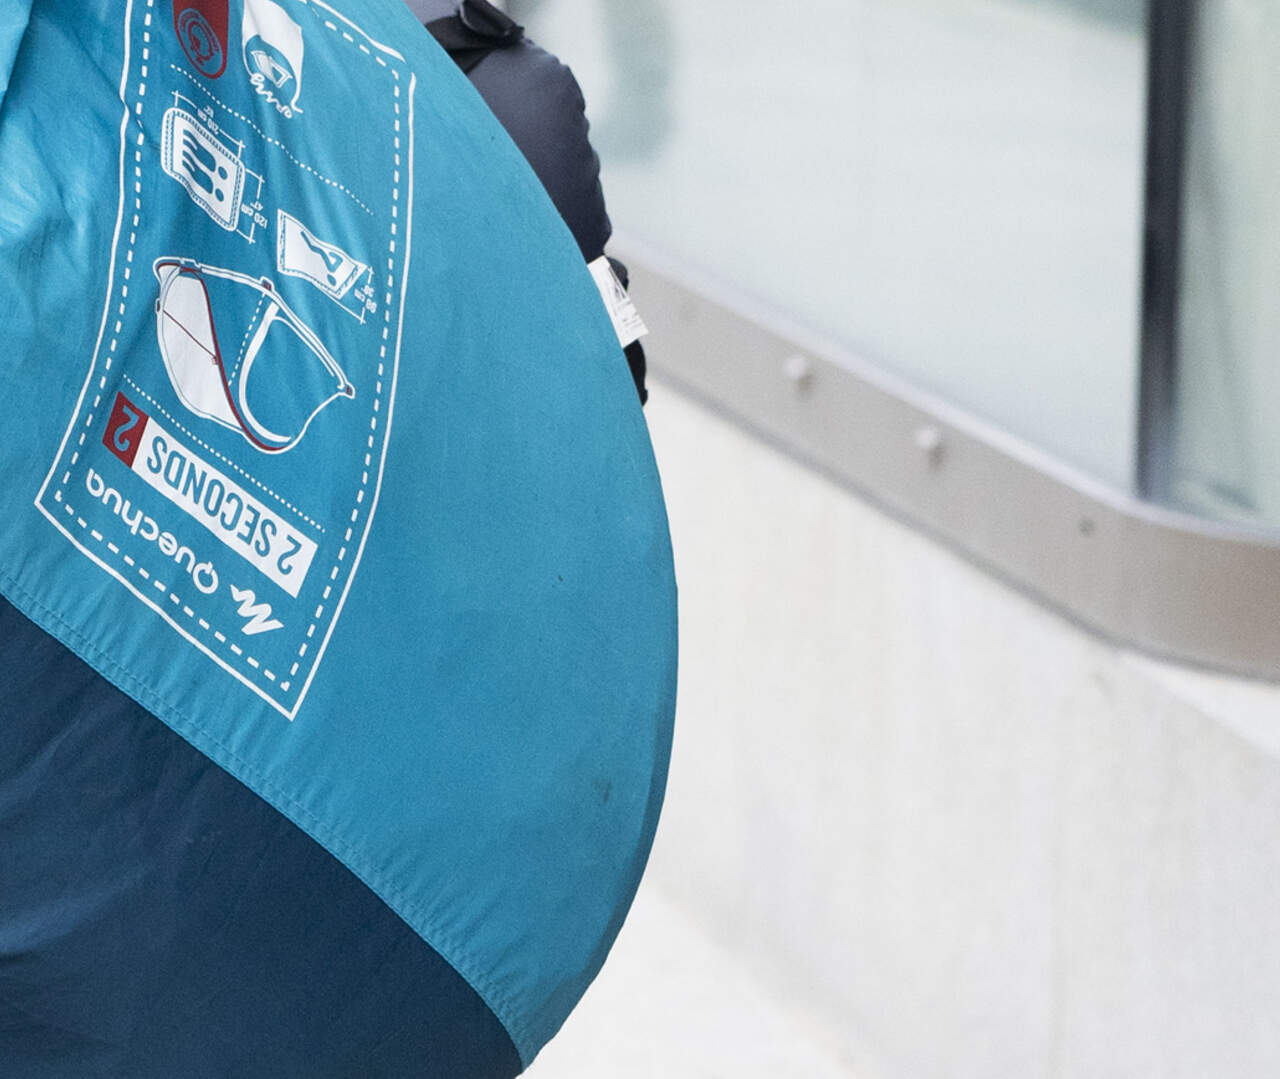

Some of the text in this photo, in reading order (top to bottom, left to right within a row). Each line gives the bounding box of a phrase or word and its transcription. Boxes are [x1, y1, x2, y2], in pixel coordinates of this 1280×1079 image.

[241, 203, 268, 229] 120 cm
[85, 468, 219, 594] Quechua
[113, 404, 302, 575] 2 SECONDS 2
